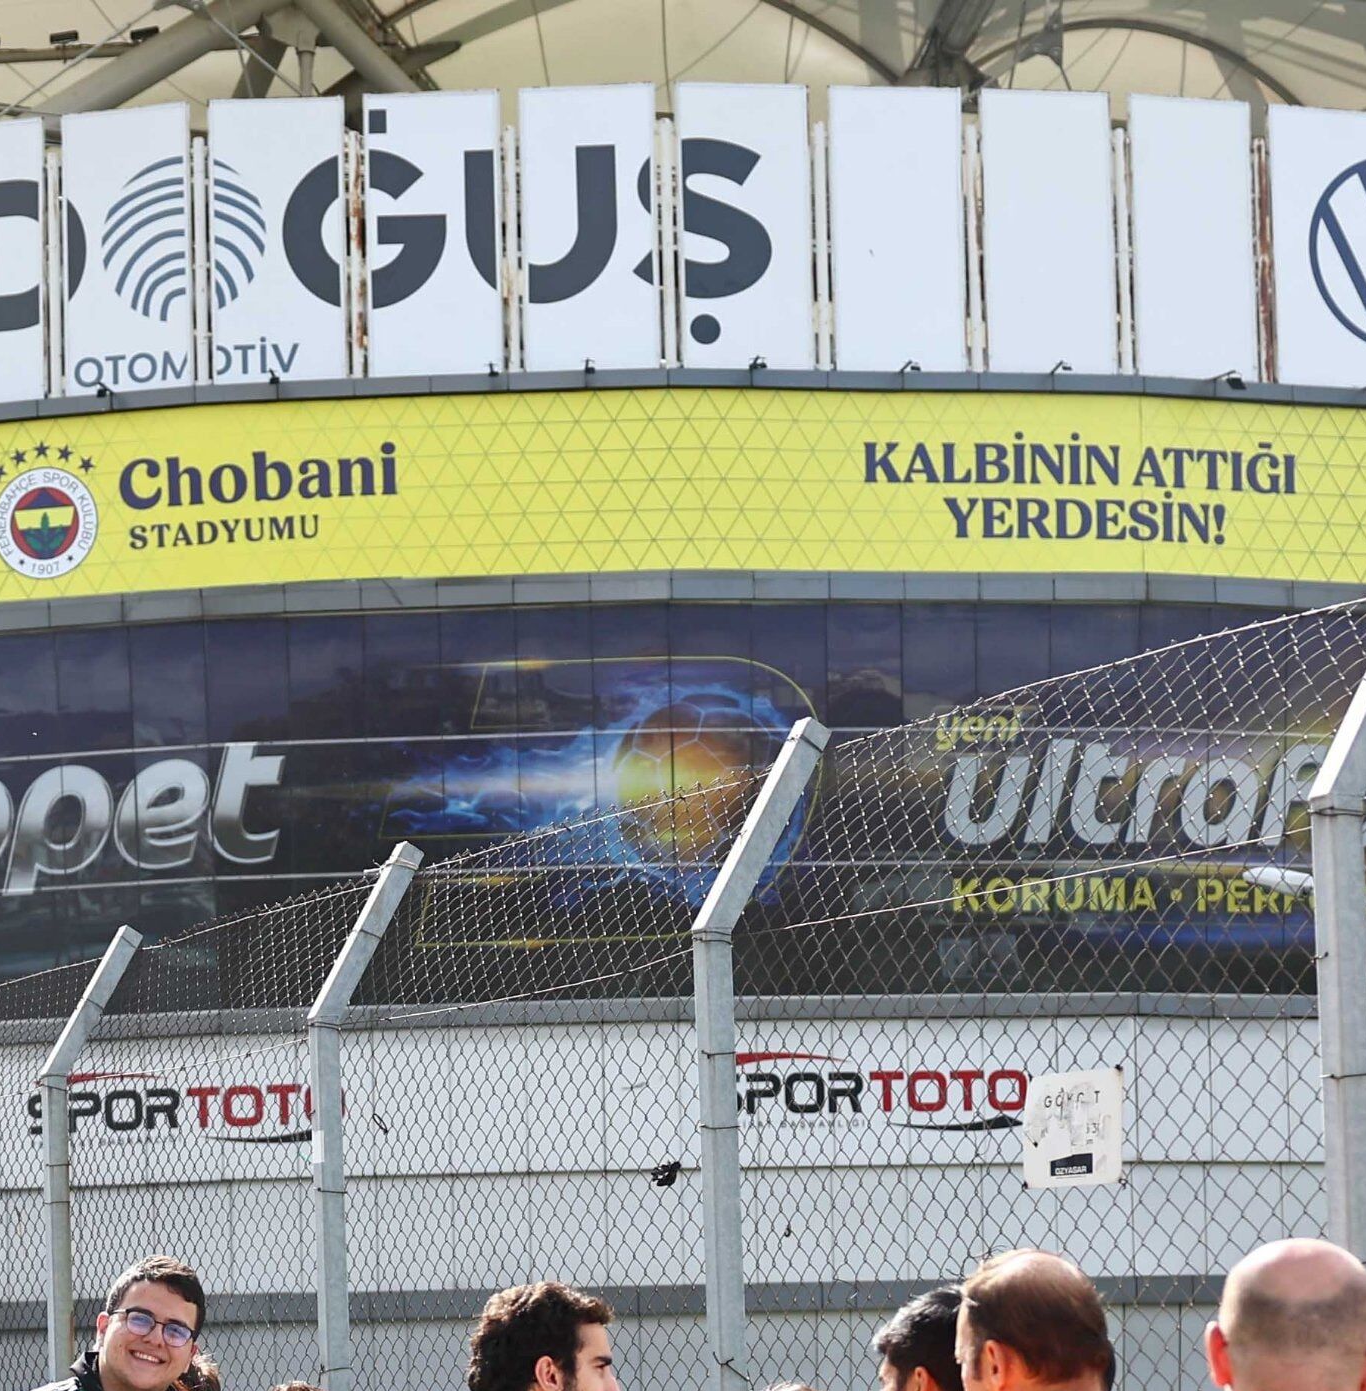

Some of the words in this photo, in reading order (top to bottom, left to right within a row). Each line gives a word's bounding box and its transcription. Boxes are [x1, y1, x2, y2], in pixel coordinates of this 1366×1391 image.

[43, 471, 80, 493] SPOR
[119, 442, 398, 510] Chobani
[863, 432, 1121, 486] KALBİNİN
[1132, 442, 1297, 494] ATTIĞI
[129, 514, 319, 550] STADYUMU
[943, 491, 1227, 545] YERDESİN!
[31, 561, 60, 575] 1907
[952, 876, 1157, 914] KORUMA
